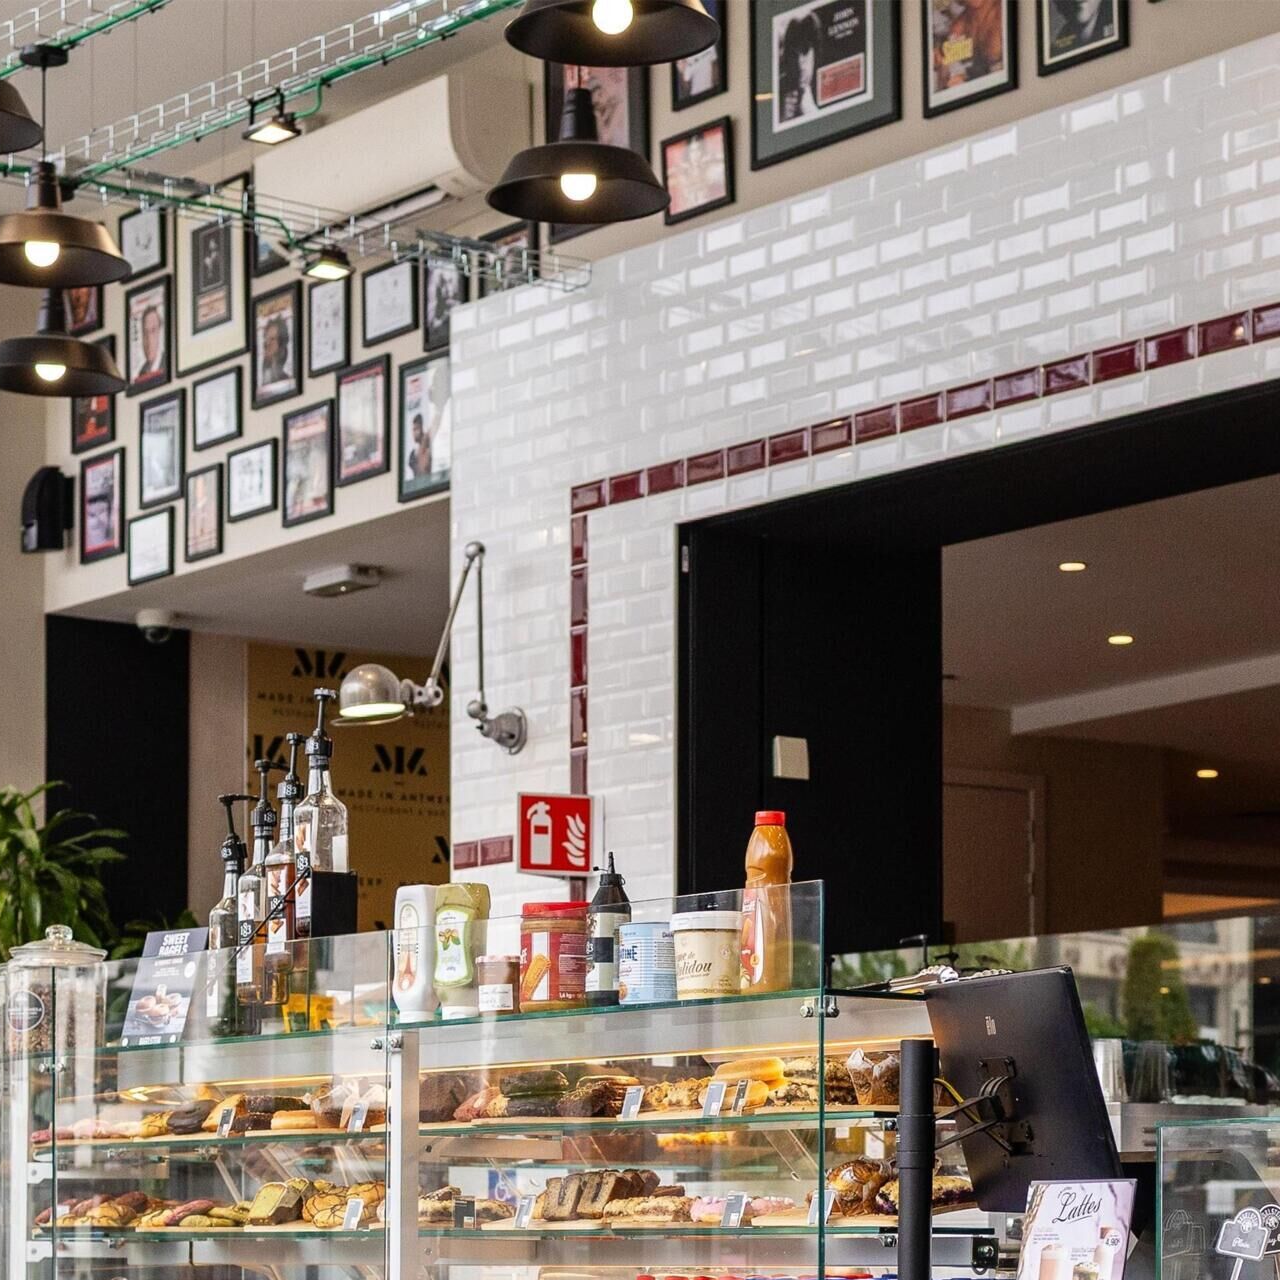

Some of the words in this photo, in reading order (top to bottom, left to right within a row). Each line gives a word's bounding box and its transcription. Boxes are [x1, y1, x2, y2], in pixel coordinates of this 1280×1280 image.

[161, 932, 190, 946] SWEET
[158, 944, 189, 956] BAGELS
[1051, 1191, 1103, 1224] Lattes
